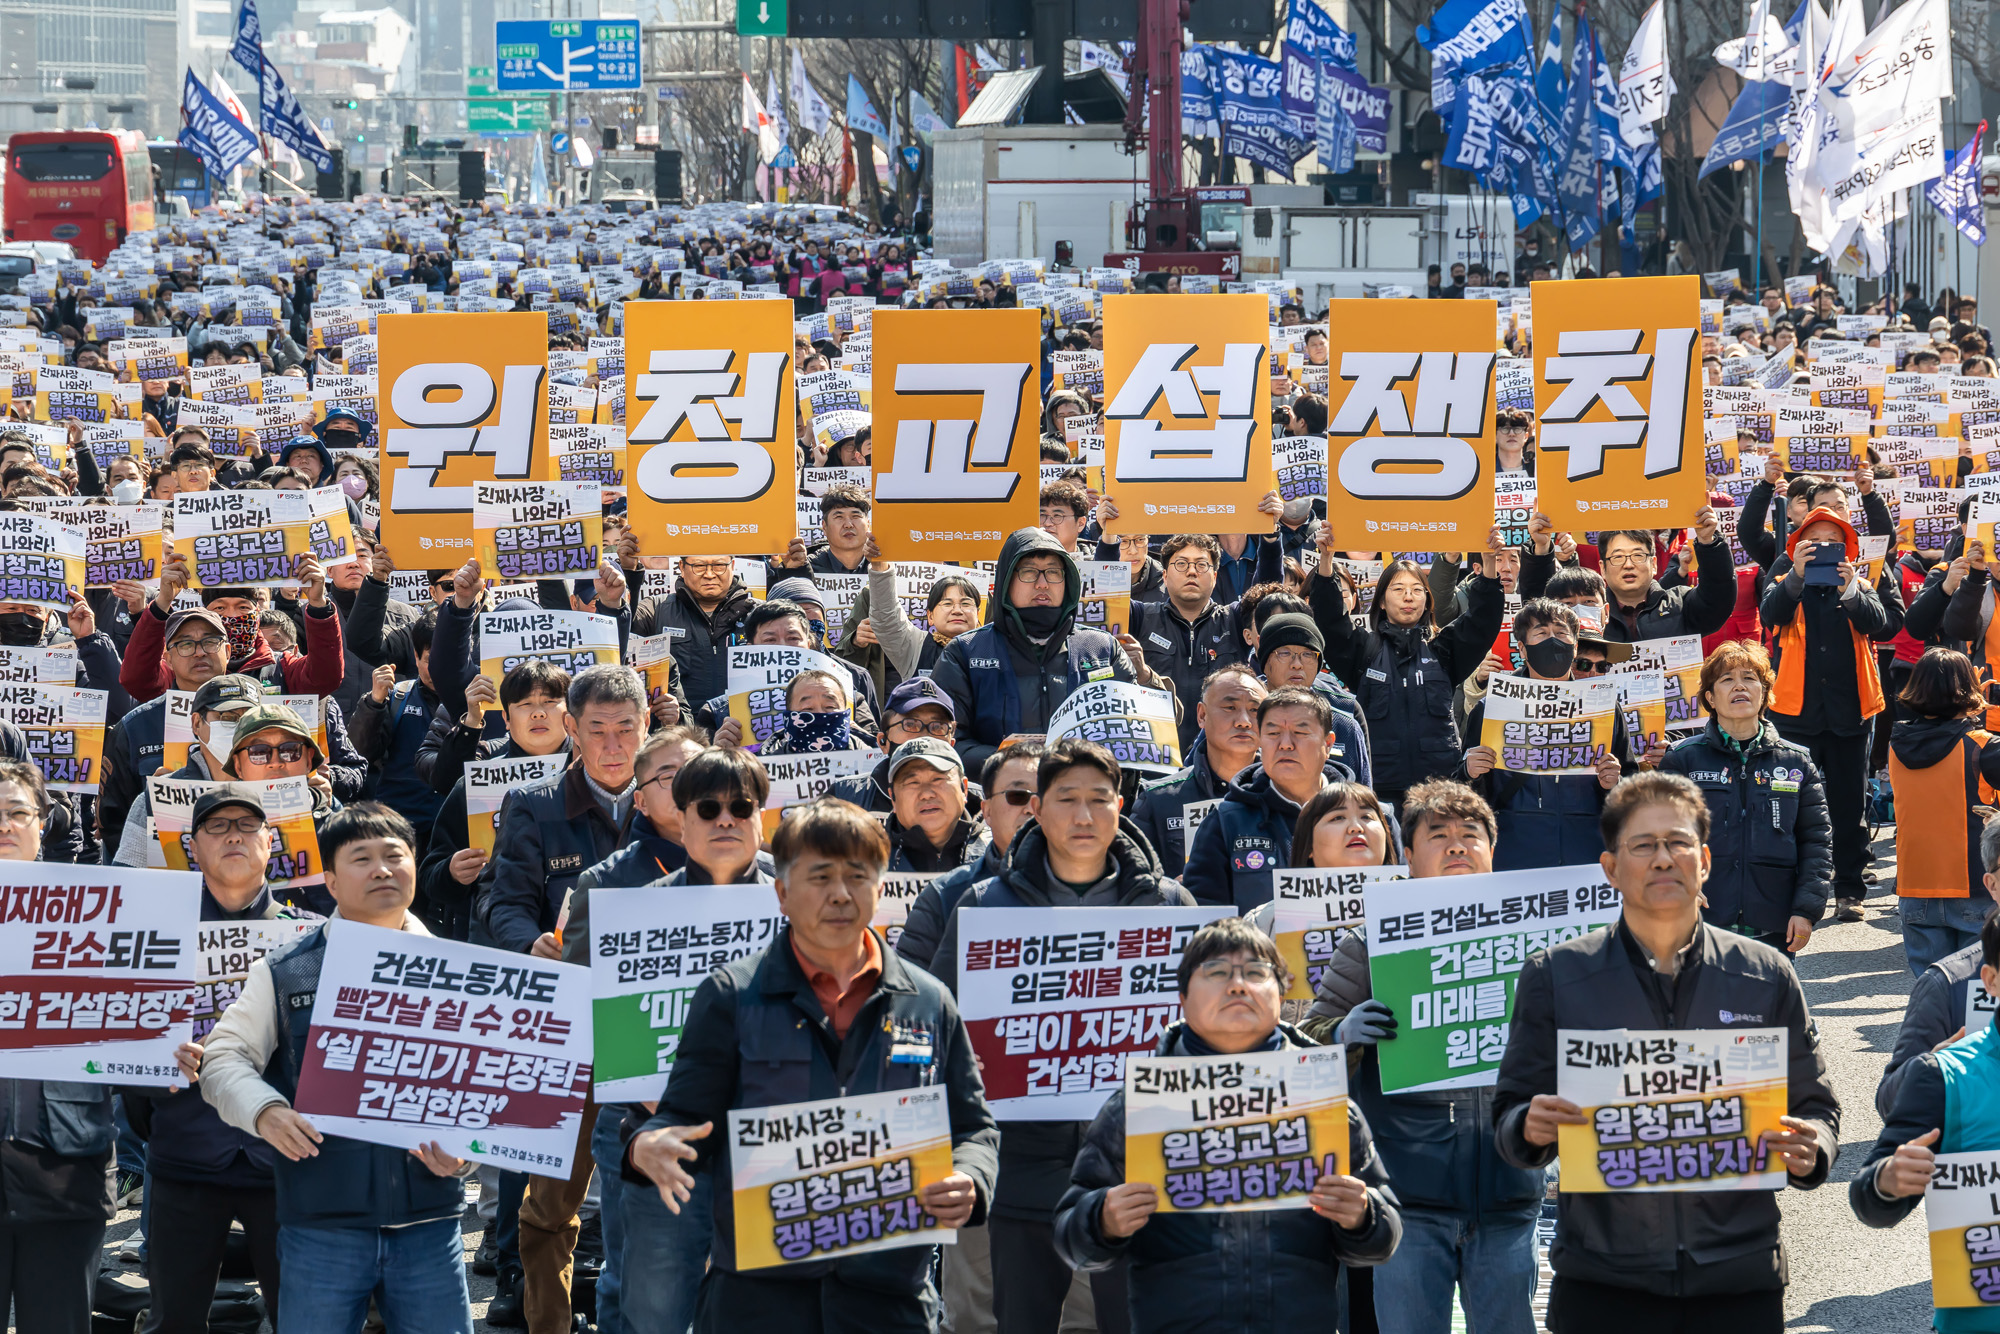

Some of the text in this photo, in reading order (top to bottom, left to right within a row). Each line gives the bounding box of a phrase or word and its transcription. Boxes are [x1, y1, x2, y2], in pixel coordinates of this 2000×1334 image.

[598, 42, 636, 53] 서소문로
[504, 60, 533, 72] 소공로
[598, 63, 636, 74] 덕수궁길
[1157, 265, 1199, 275] KATO
[128, 339, 158, 350] 진짜사장
[143, 347, 172, 358] 나와라!
[136, 355, 177, 368] 원청교섭
[1056, 352, 1087, 364] 진짜사장
[1071, 359, 1100, 371] 나와라!
[41, 367, 79, 380] 진짜사장
[194, 367, 227, 381] 진짜사장
[210, 376, 243, 388] 나와라!
[801, 372, 837, 387] 진짜사장
[1812, 365, 1847, 379] 진짜사장
[1827, 375, 1862, 387] 나와라!
[59, 379, 93, 391] 나와라!
[819, 378, 853, 391] 나와라!
[48, 391, 99, 409] 원청교섭
[811, 390, 860, 406] 원청교섭
[1540, 328, 1698, 484] 취
[1716, 392, 1751, 403] 진짜사장
[1732, 402, 1766, 413] 나와라!
[1820, 389, 1868, 405] 원청교섭
[49, 406, 105, 422] 쟁취하자!
[1104, 344, 1266, 482] 섭
[1779, 407, 1826, 423] 진짜사장
[549, 426, 589, 441] 진짜사장
[628, 350, 790, 503] 청
[874, 364, 1033, 502] 교
[1328, 352, 1497, 500] 쟁
[1802, 420, 1844, 435] 나와라!
[387, 363, 546, 514] 원
[568, 436, 607, 453] 나와라!
[1788, 436, 1851, 455] 원청교섭
[558, 450, 614, 472] 원청교섭
[1288, 449, 1325, 465] 나와라!
[1788, 453, 1861, 473] 쟁취하자!
[178, 495, 244, 516] 진짜사장
[478, 486, 545, 509] 진짜사장
[1593, 498, 1669, 514] 전국금속노동조합
[1903, 490, 1949, 506] 진짜사장
[212, 509, 273, 532] 나와라!
[512, 499, 572, 523] 나와라!
[1160, 503, 1236, 517] 전국금속노동조합
[495, 522, 583, 552] 원청교섭
[682, 522, 759, 537] 전국금속노동조합
[925, 529, 1002, 543] 전국금속노동조합
[1381, 521, 1457, 535] 전국금속노동조합
[195, 532, 285, 560] 원청교섭
[498, 545, 597, 577] 쟁취하자!
[484, 613, 555, 635] 진짜사장
[520, 628, 583, 653] 나와라!
[731, 650, 802, 669] 진짜사장
[1491, 678, 1561, 701] 진짜사장
[1074, 697, 1138, 723] 나와라!
[1525, 697, 1583, 720] 나와라!
[1504, 721, 1592, 747] 원청교섭
[1501, 745, 1606, 772] 쟁취하자!
[470, 761, 545, 788] 진짜사장
[1235, 837, 1271, 850] 단결투쟁
[550, 856, 581, 869] 단결투쟁
[1279, 872, 1367, 900] 진짜사장
[1379, 918, 1425, 943] 모든
[1430, 888, 1569, 937] 건설노동자를
[599, 930, 643, 957] 청년
[646, 919, 755, 953] 건설노동자
[31, 930, 181, 970] 감소되는
[371, 950, 561, 1004] 건설노동자도
[618, 960, 683, 984] 안정적
[1011, 959, 1180, 1005] 임금체불 없는
[332, 985, 573, 1046] 빨간날 쉴 수 있는
[1411, 979, 1509, 1031] 미래를
[1747, 1034, 1780, 1046] 민주노총
[1309, 1051, 1339, 1064] 민주노총
[1565, 1037, 1678, 1069] 진짜사장
[107, 1061, 181, 1078] 전국건설노동조합
[364, 1035, 473, 1085] 권리가
[469, 1049, 580, 1098] 보장된
[1133, 1062, 1245, 1096] 진짜사장
[1623, 1059, 1723, 1098] 나와라!
[911, 1091, 940, 1105] 민주노총
[1191, 1080, 1289, 1122] 나와라!
[738, 1106, 847, 1147] 진짜사장
[1594, 1095, 1743, 1145] 원청교섭
[796, 1123, 893, 1171] 나와라!
[1162, 1115, 1310, 1170] 원청교섭
[490, 1143, 563, 1169] 전국건설노동조합
[1597, 1134, 1770, 1189] 쟁취하자!
[770, 1159, 913, 1220] 원청교섭
[1165, 1153, 1336, 1210] 쟁취하자!
